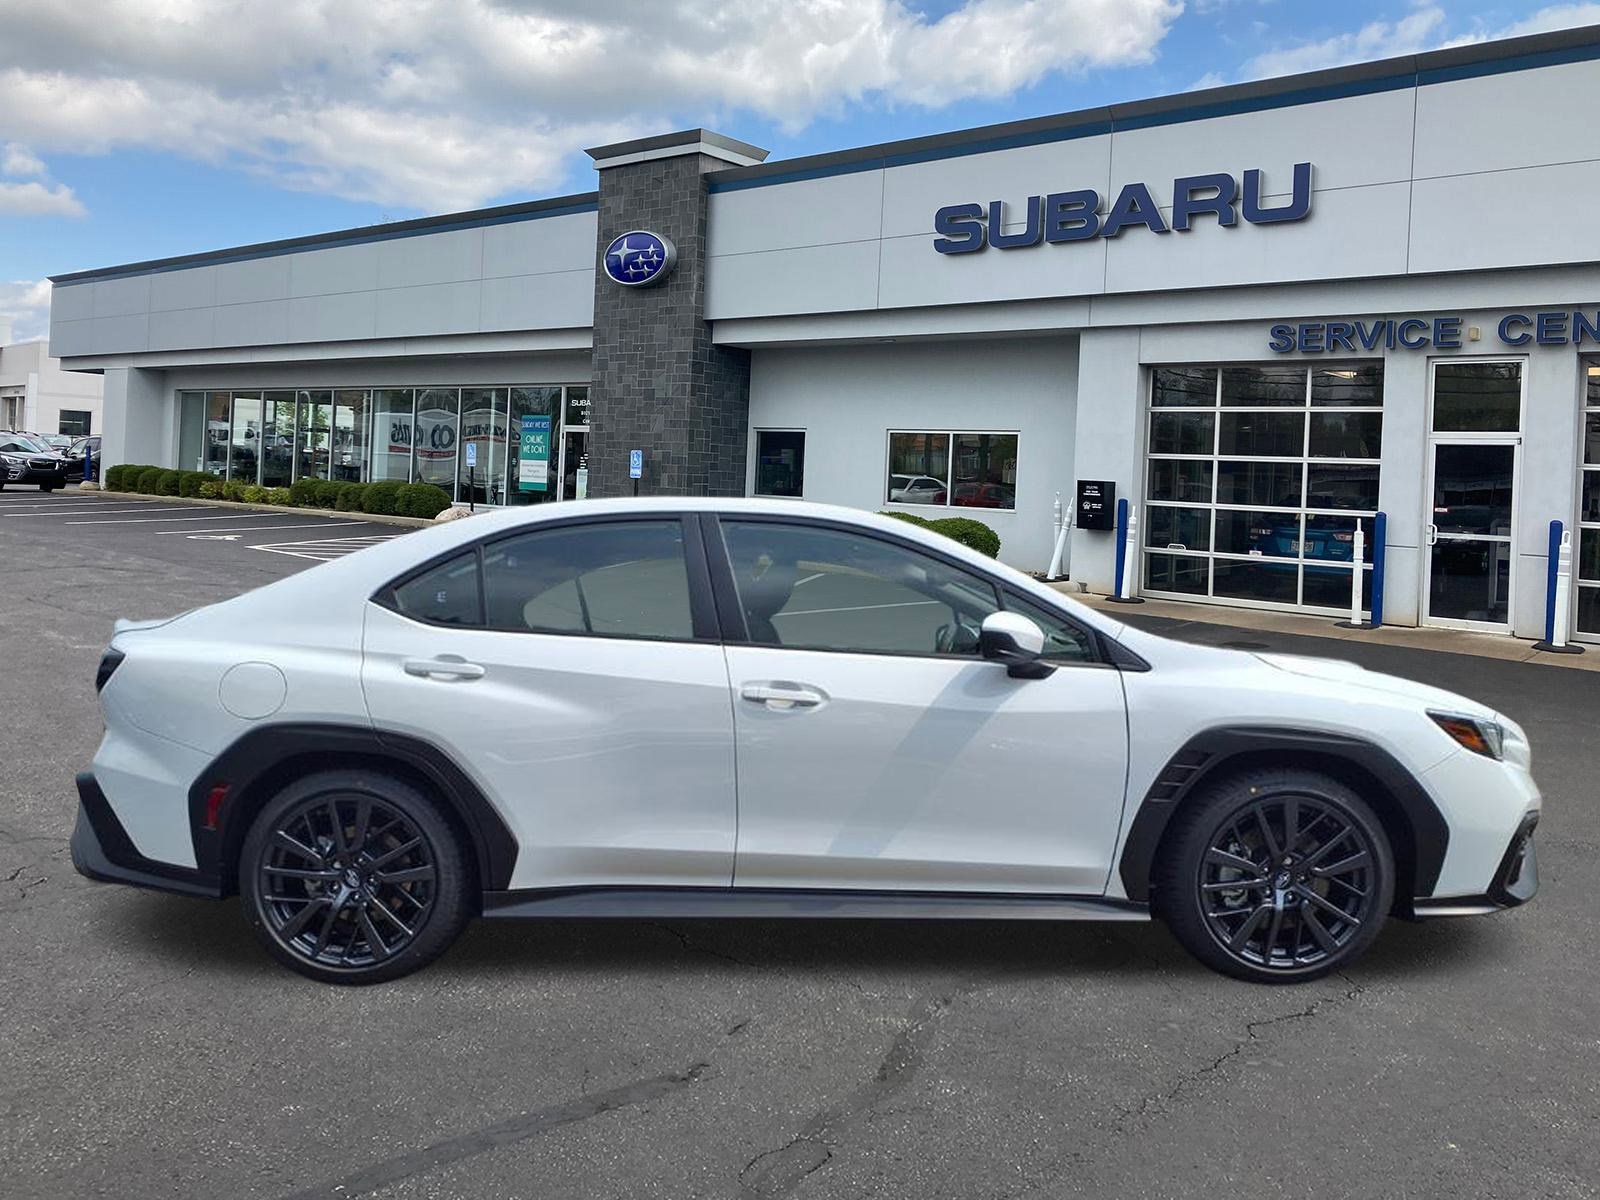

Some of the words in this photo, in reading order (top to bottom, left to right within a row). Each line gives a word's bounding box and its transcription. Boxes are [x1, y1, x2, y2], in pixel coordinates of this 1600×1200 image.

[933, 162, 1313, 255] SUBARU
[1268, 317, 1462, 353] SERVICE
[1497, 310, 1600, 346] CEN
